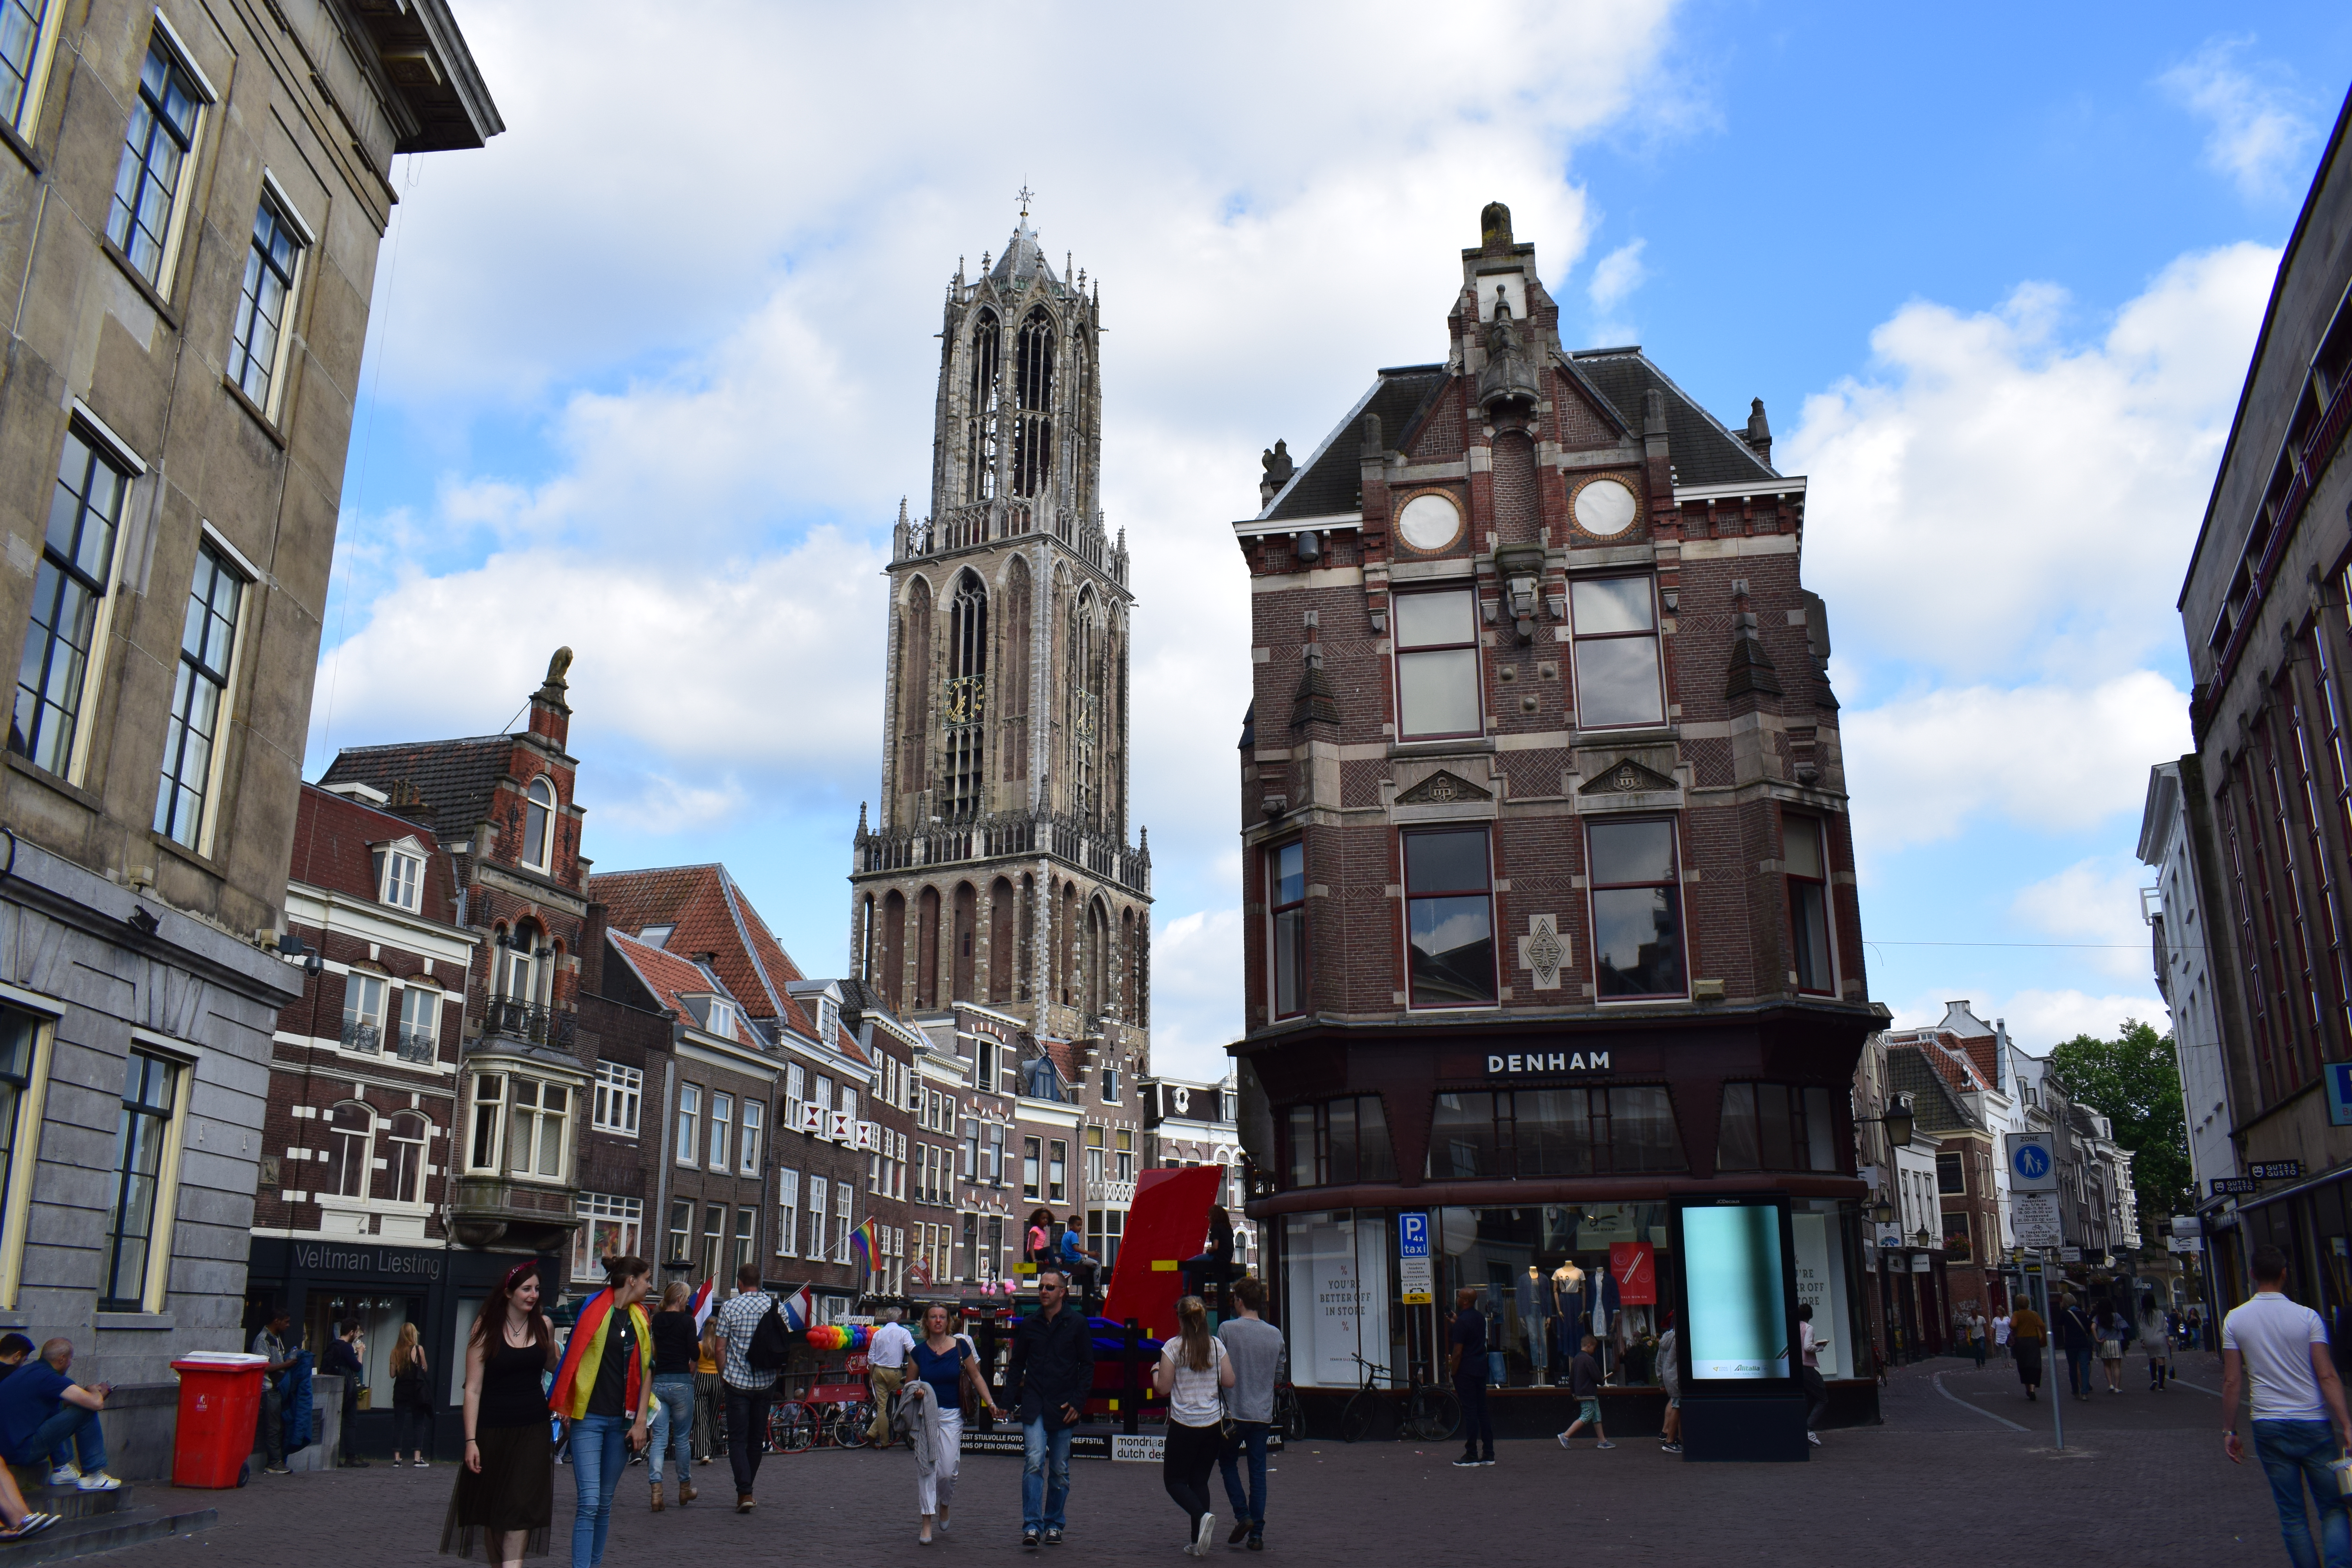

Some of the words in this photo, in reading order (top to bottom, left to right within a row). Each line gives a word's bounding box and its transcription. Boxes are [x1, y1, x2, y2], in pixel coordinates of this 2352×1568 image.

[1488, 1051, 1609, 1073] DENHAM
[2343, 1107, 2352, 1116] B
[1406, 1218, 1421, 1240] P
[1405, 1244, 1426, 1253] taxi
[296, 1245, 370, 1270] Veltman
[378, 1250, 440, 1280] Liesting
[1808, 1283, 1824, 1292] OFF
[1320, 1294, 1352, 1302] BETTER
[1326, 1307, 1335, 1316] IN
[1117, 1436, 1166, 1447] mondriaa
[1117, 1448, 1145, 1459] dutch
